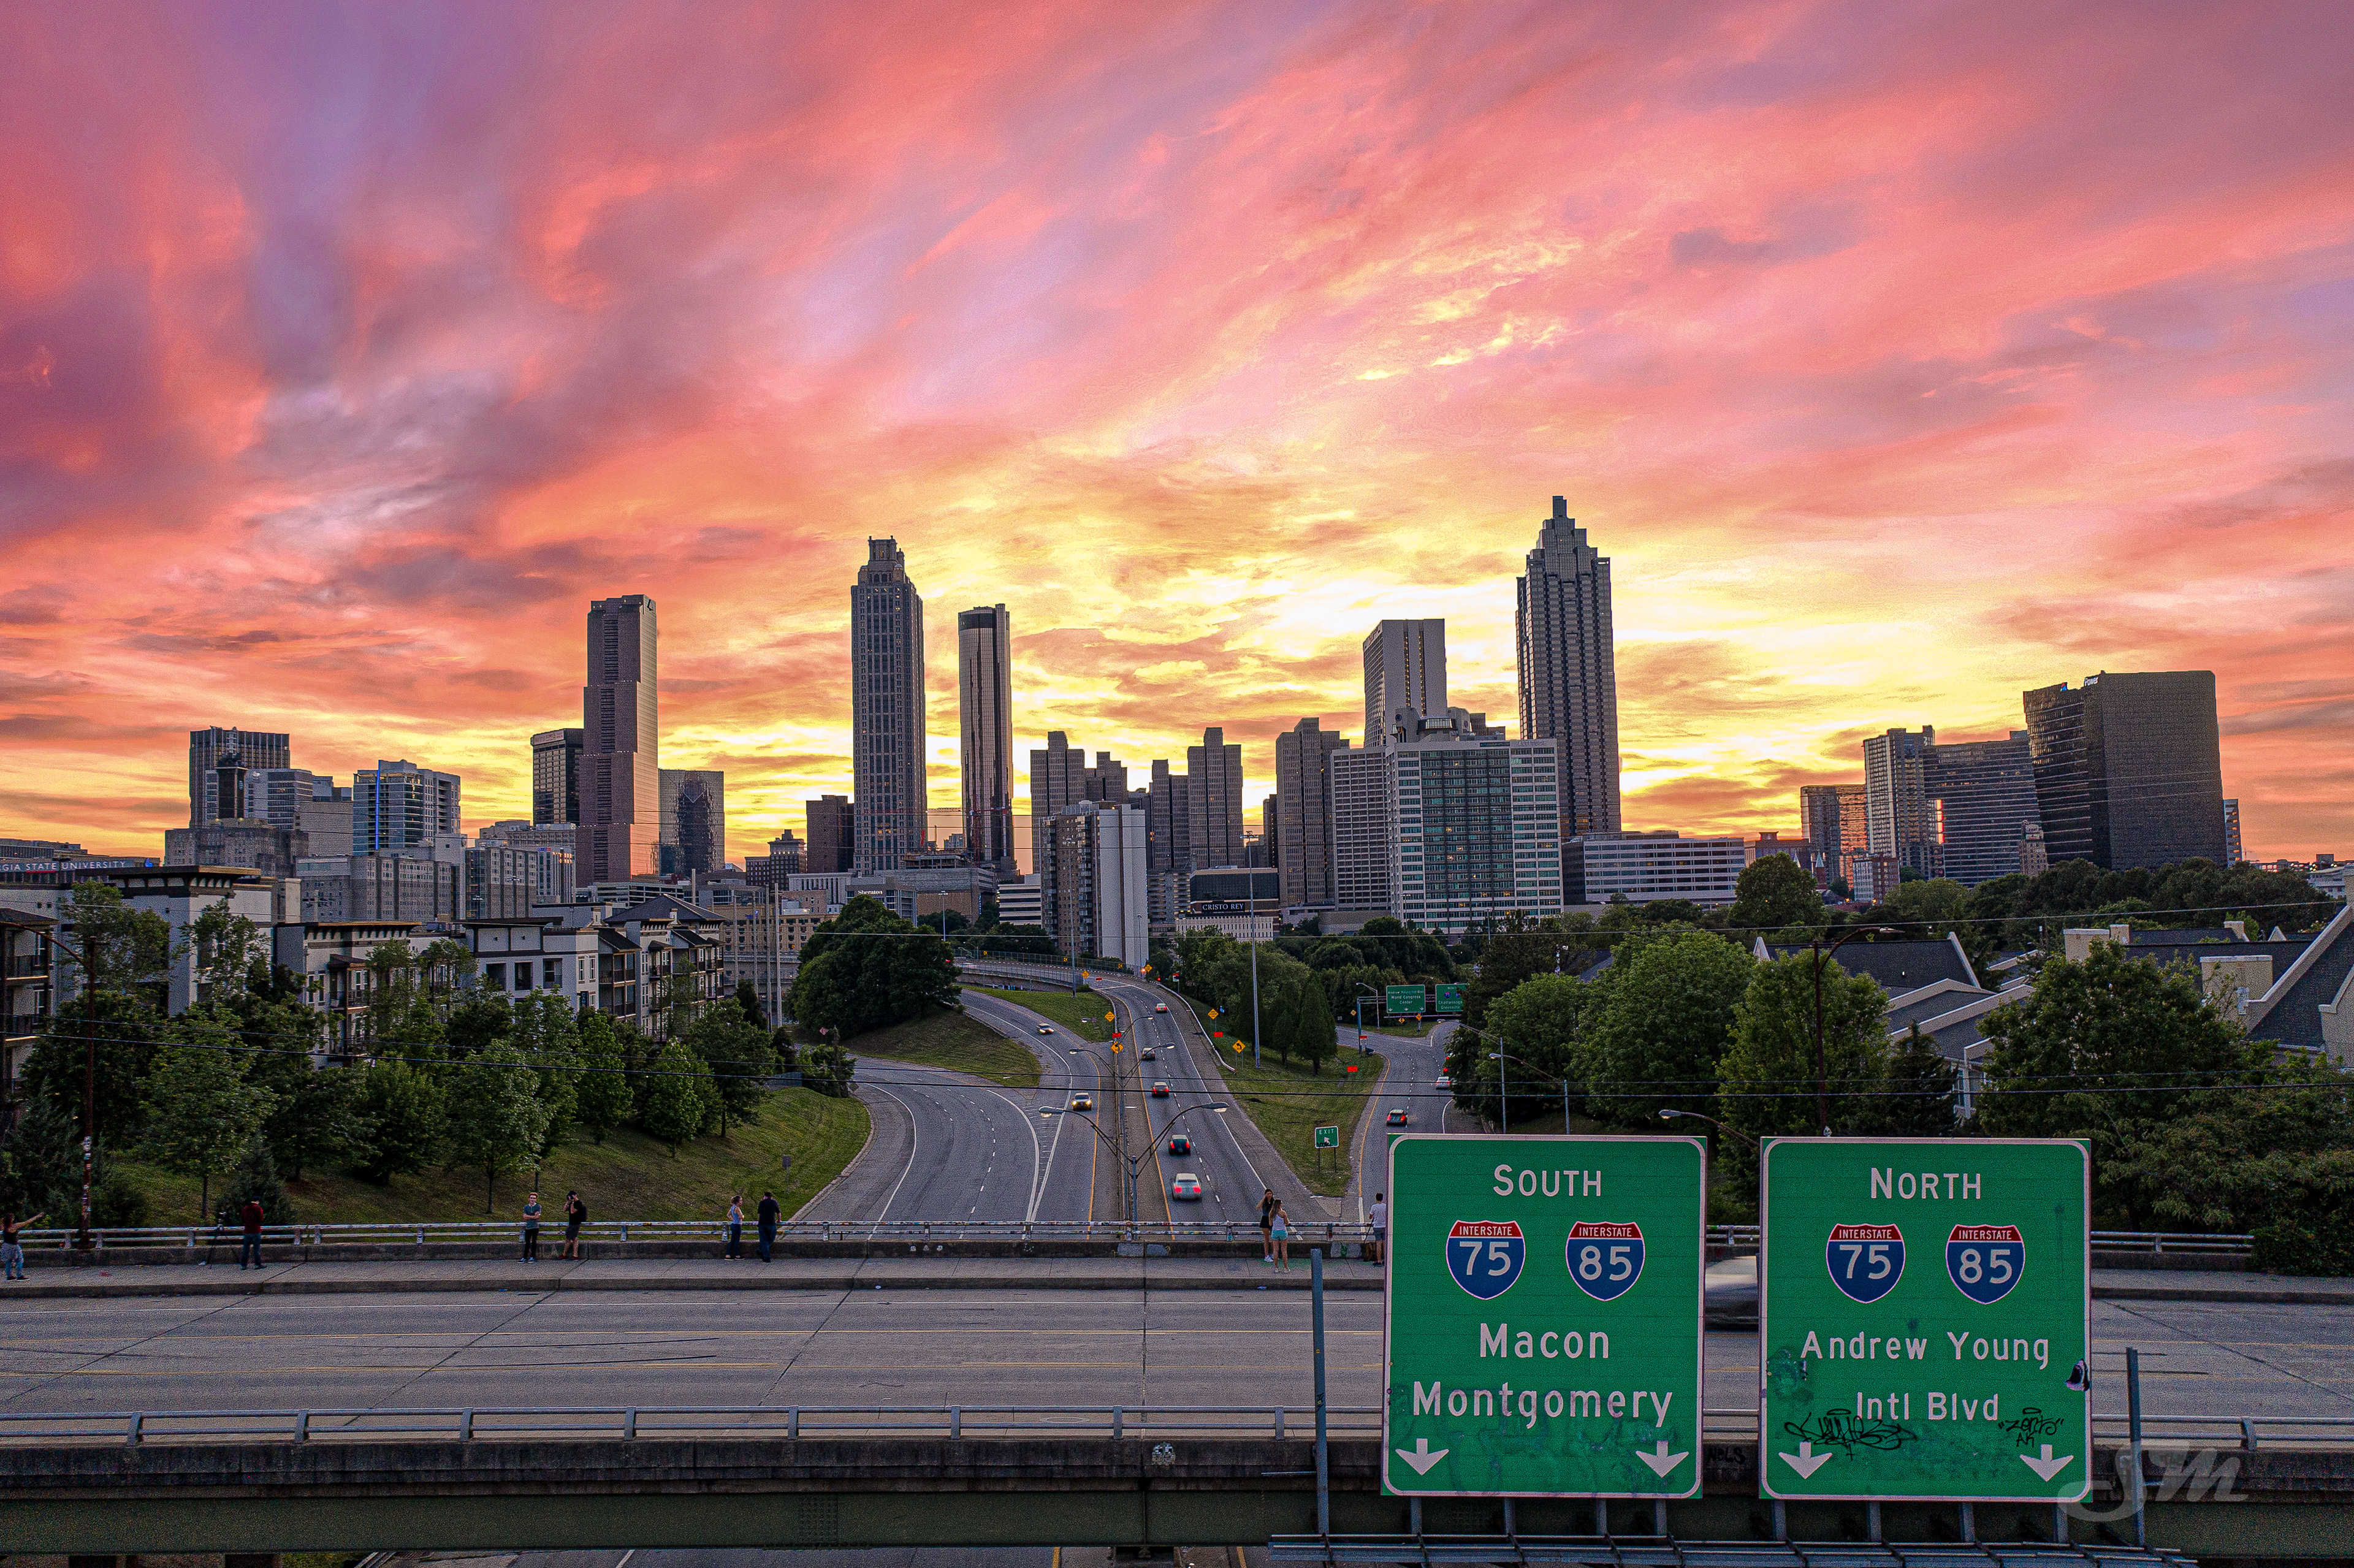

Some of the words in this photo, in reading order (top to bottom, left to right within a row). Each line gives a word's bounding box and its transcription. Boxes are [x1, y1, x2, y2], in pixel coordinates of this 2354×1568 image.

[2084, 677, 2098, 687] Power
[62, 861, 126, 869] UNIVERSITY
[1493, 1164, 1601, 1197] SOUTH
[1870, 1167, 1981, 1199] NORTH
[1459, 1225, 1513, 1236] INTERSTATE
[1579, 1227, 1632, 1237] INTERSTATE
[1839, 1229, 1892, 1239] INTERSTATE
[1959, 1230, 2012, 1240] INTERSTATE
[1459, 1241, 1511, 1276] 75
[1579, 1246, 1632, 1281] 85
[1839, 1244, 1891, 1279] 75
[1959, 1249, 2013, 1284] 85
[1480, 1323, 1609, 1358] Macon
[1800, 1331, 1927, 1360] Andrew
[1946, 1331, 2049, 1369] Young
[1413, 1381, 1673, 1429] Montgomery
[1857, 1392, 1910, 1420] Intl
[1927, 1392, 1998, 1421] Blvd
